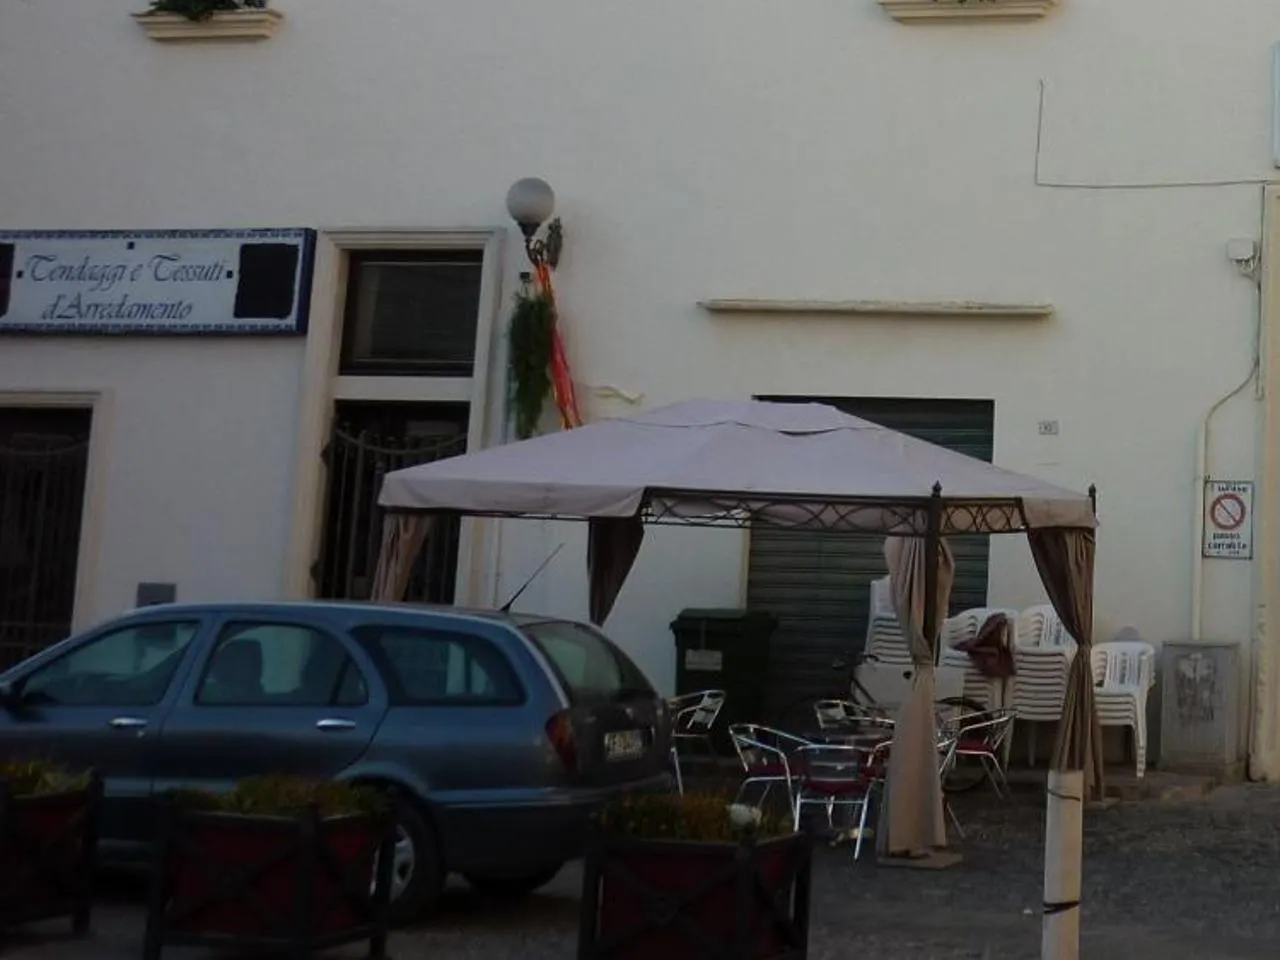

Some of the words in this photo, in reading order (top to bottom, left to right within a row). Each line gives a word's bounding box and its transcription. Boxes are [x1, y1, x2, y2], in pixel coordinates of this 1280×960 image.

[25, 254, 128, 291] Tendaggi
[129, 263, 143, 282] e
[148, 254, 225, 283] Tessuti
